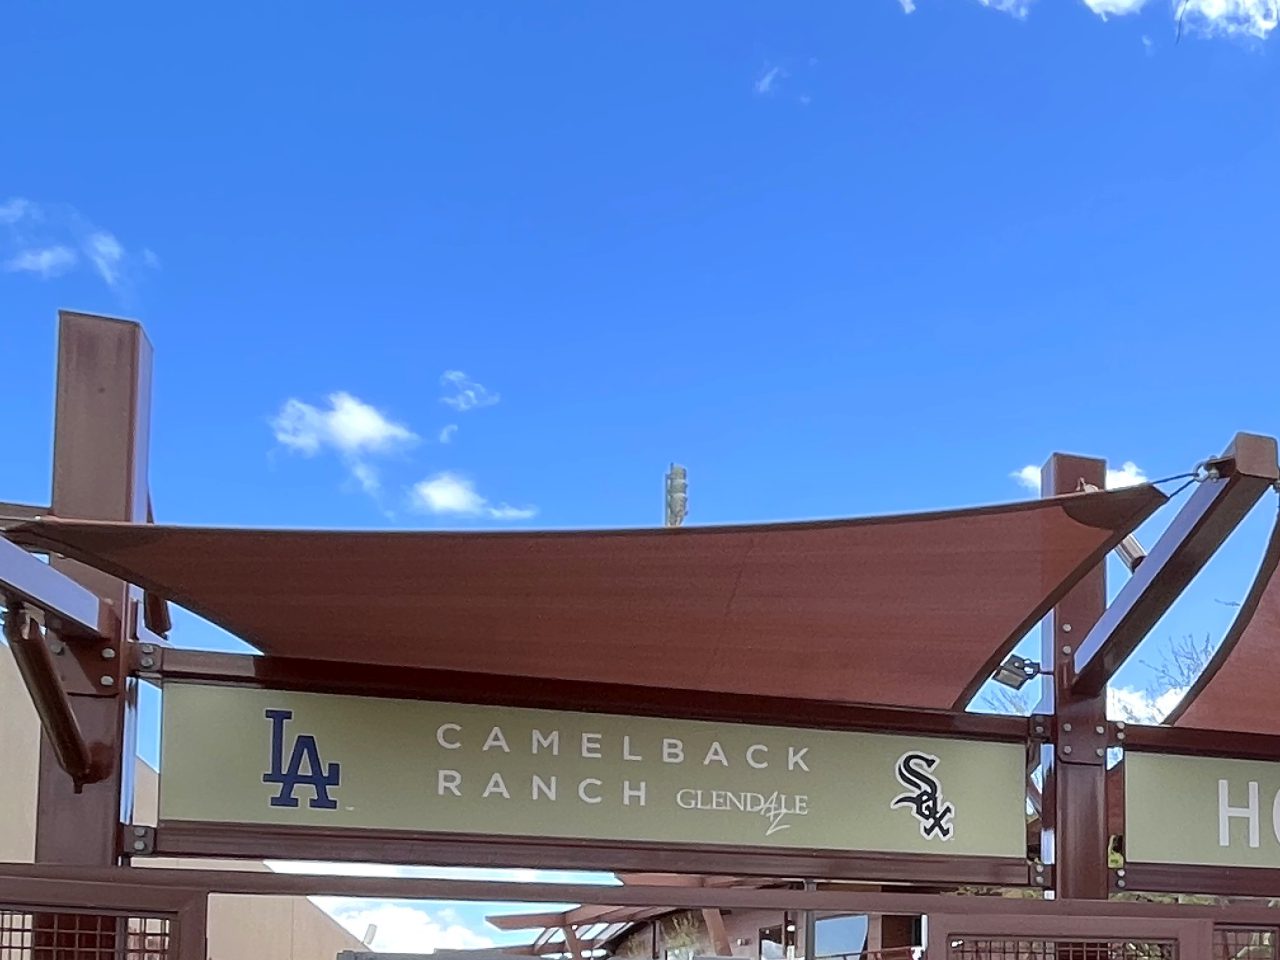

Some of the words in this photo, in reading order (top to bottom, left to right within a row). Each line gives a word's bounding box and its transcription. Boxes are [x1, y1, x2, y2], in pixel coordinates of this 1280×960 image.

[262, 709, 340, 809] LA
[436, 723, 810, 772] CAMELBACK
[437, 769, 647, 807] RANCH
[676, 788, 809, 827] GLENDALE
